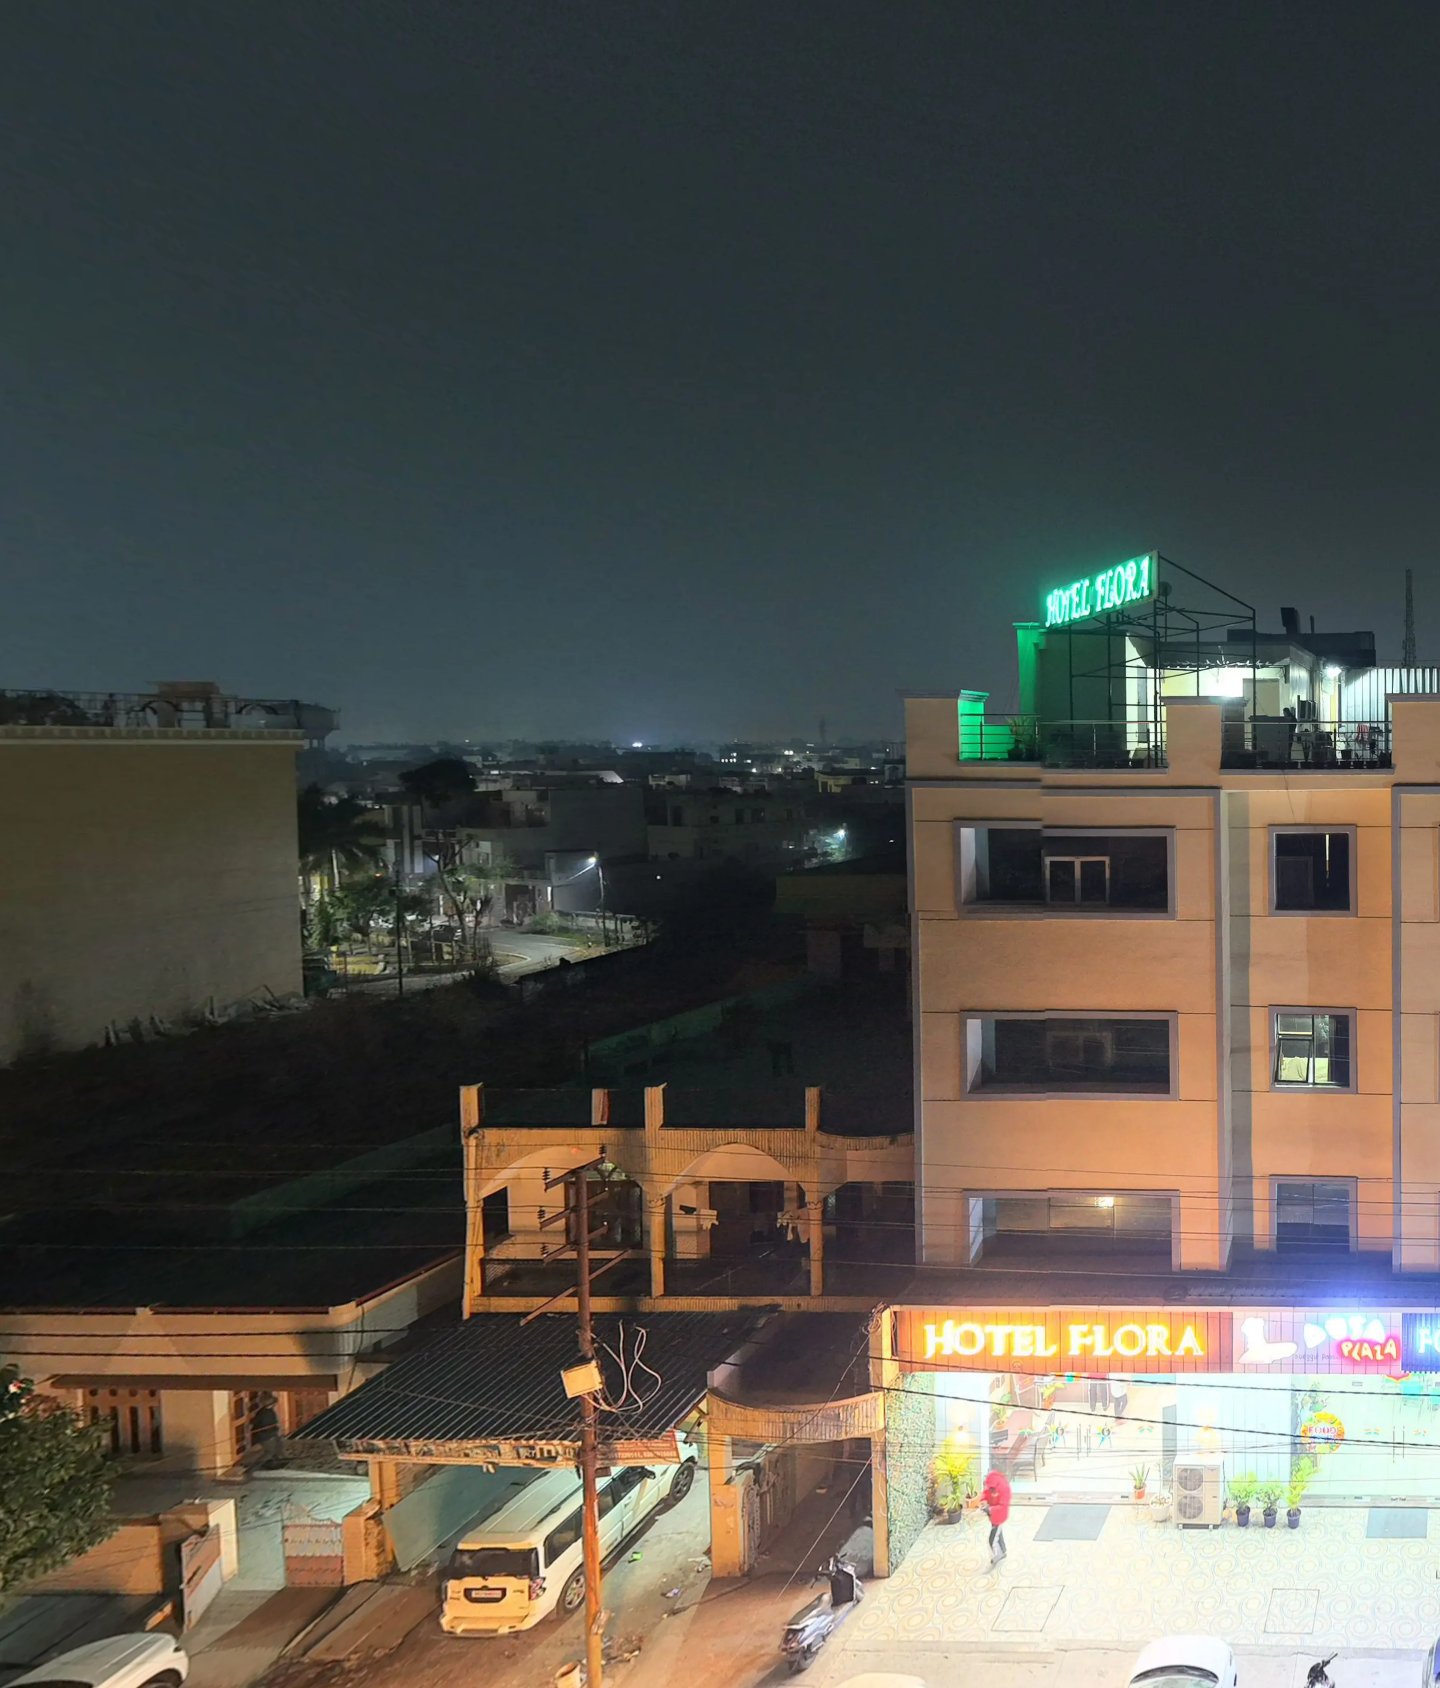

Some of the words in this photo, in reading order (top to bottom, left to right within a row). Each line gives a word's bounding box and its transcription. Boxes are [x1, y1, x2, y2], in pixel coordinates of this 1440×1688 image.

[1045, 578, 1091, 627] HOTEL
[1095, 555, 1150, 612] FLORA
[923, 1319, 1057, 1359] HOTEL
[1067, 1323, 1205, 1356] FLORA
[1340, 1338, 1397, 1362] PLAZA
